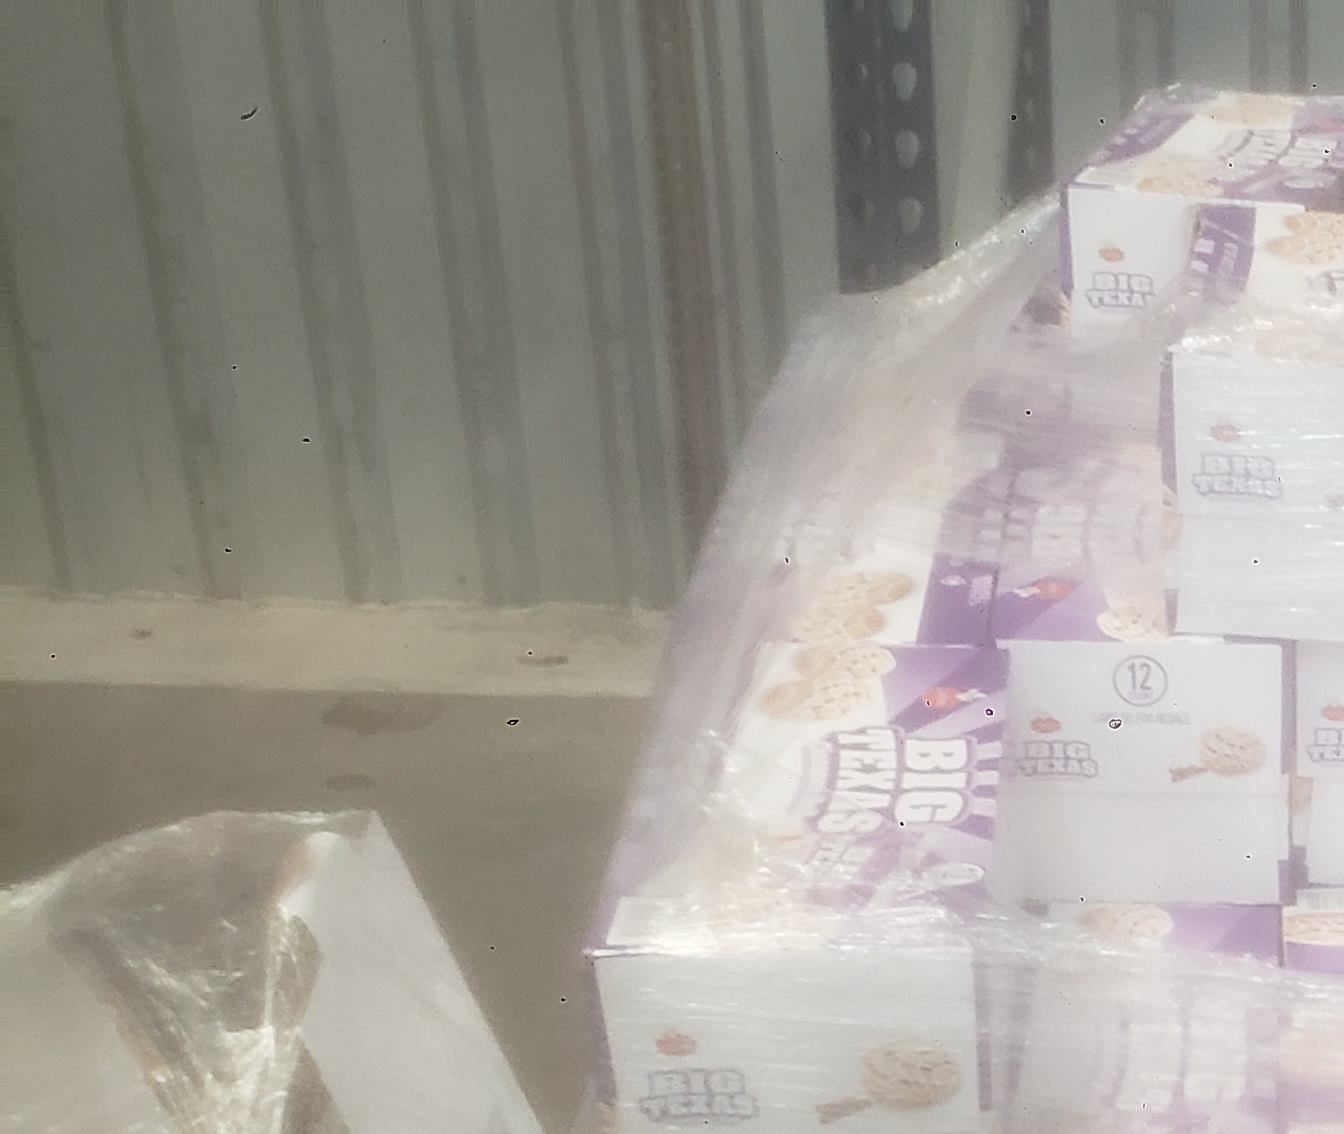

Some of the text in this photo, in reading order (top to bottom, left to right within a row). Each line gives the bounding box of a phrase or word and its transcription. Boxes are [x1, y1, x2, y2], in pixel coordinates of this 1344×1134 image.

[1093, 272, 1154, 293] BIG
[1127, 662, 1153, 692] 12
[1025, 739, 1091, 760] BIG
[817, 729, 898, 834] TEXAS
[895, 738, 969, 823] BIG
[648, 1068, 746, 1096] BIG
